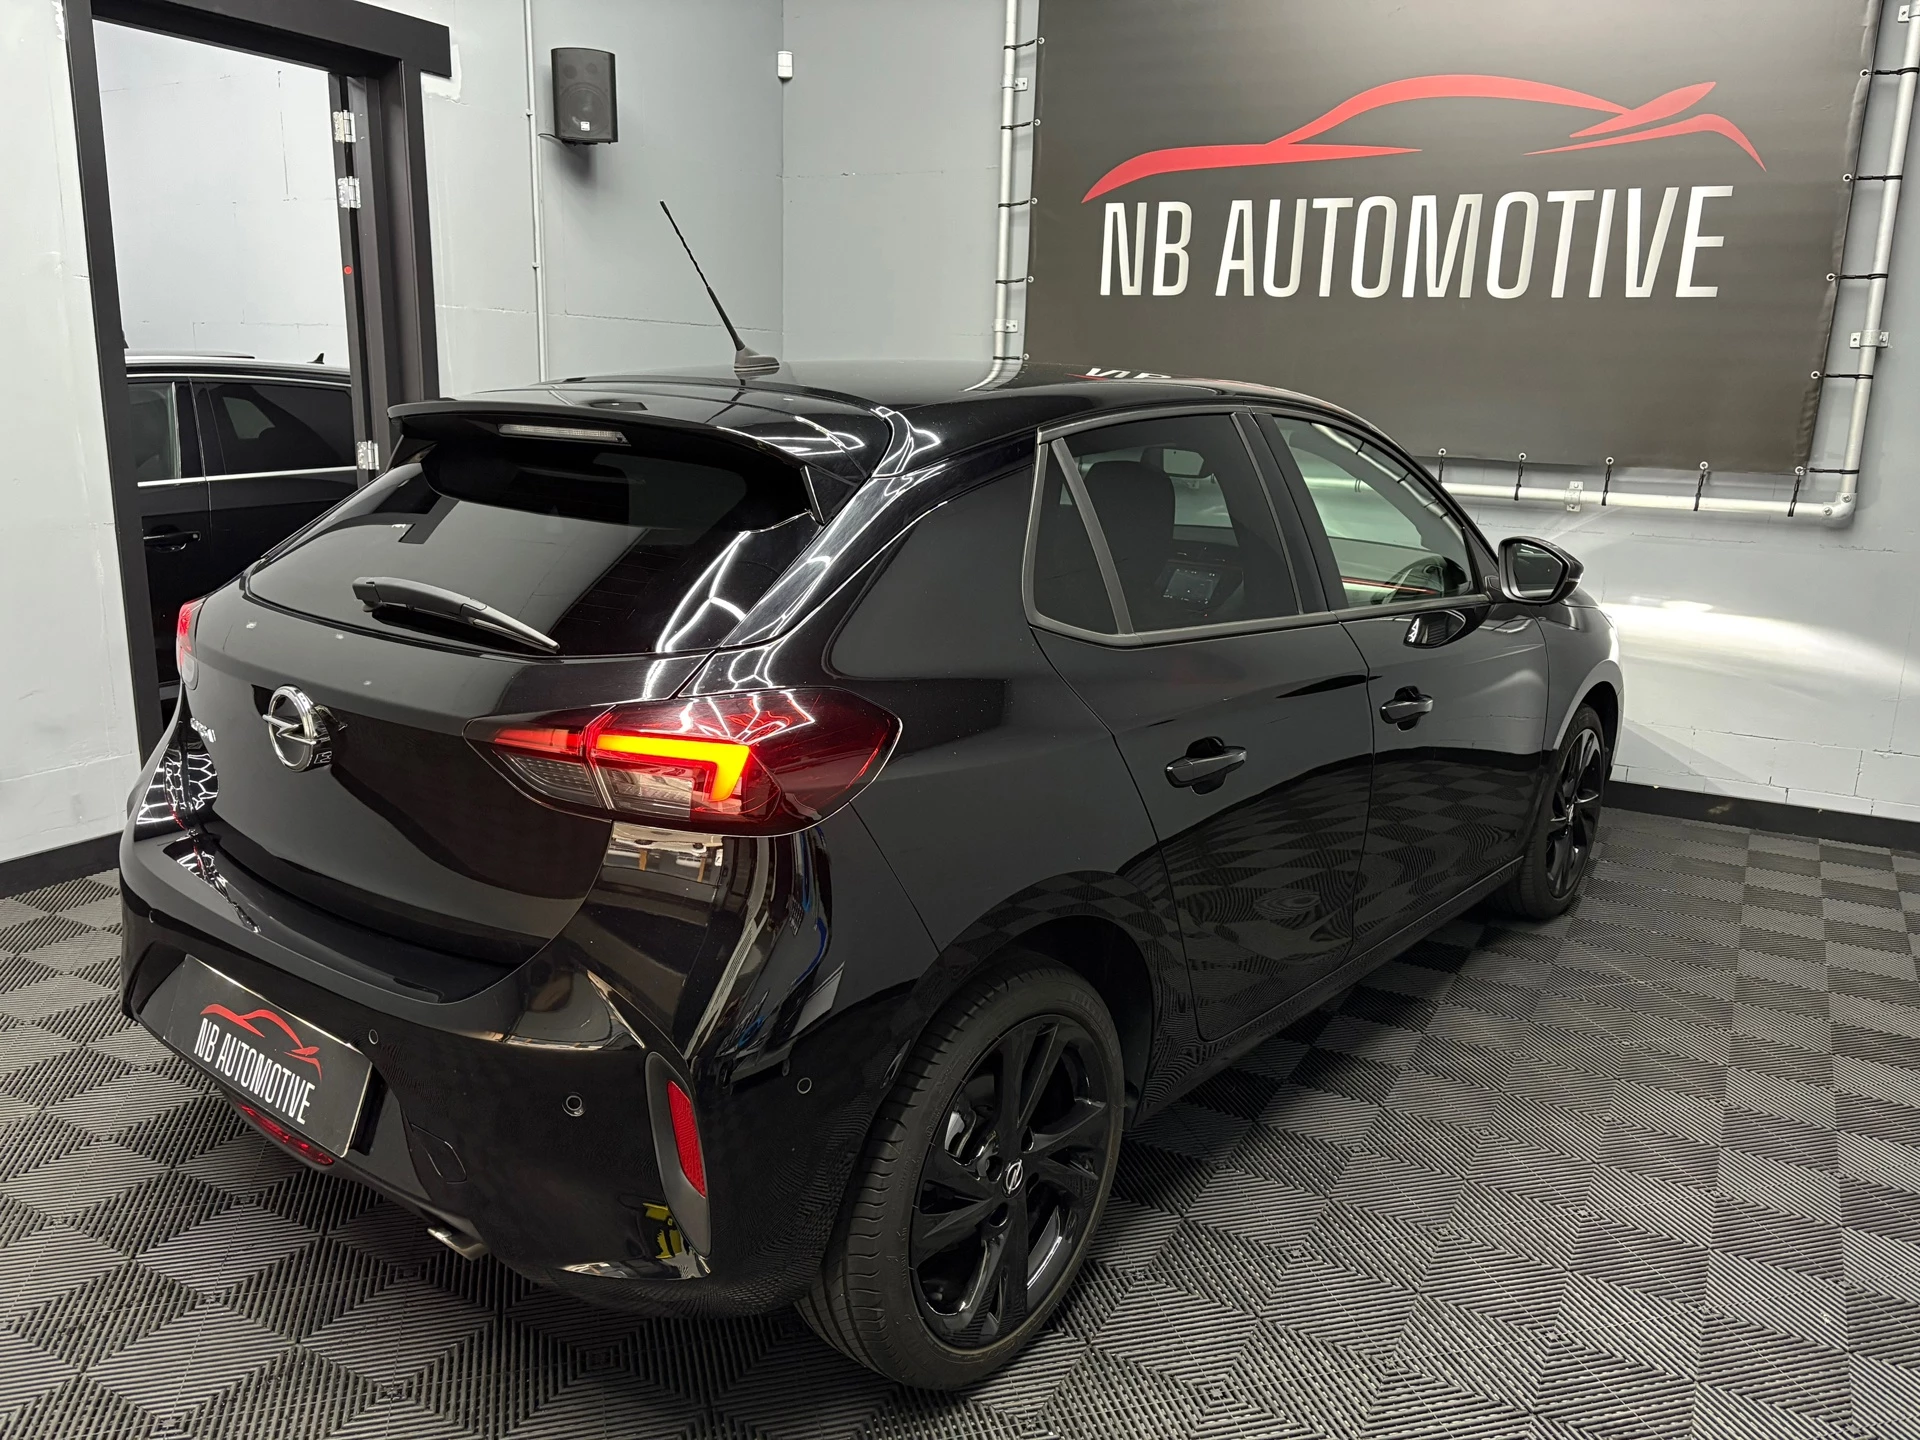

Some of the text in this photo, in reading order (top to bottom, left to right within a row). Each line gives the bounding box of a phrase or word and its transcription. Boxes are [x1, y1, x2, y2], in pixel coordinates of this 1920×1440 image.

[1100, 185, 1734, 299] NB AUTOMOTIVE
[194, 1018, 315, 1125] NB AUTOMOTIVE
